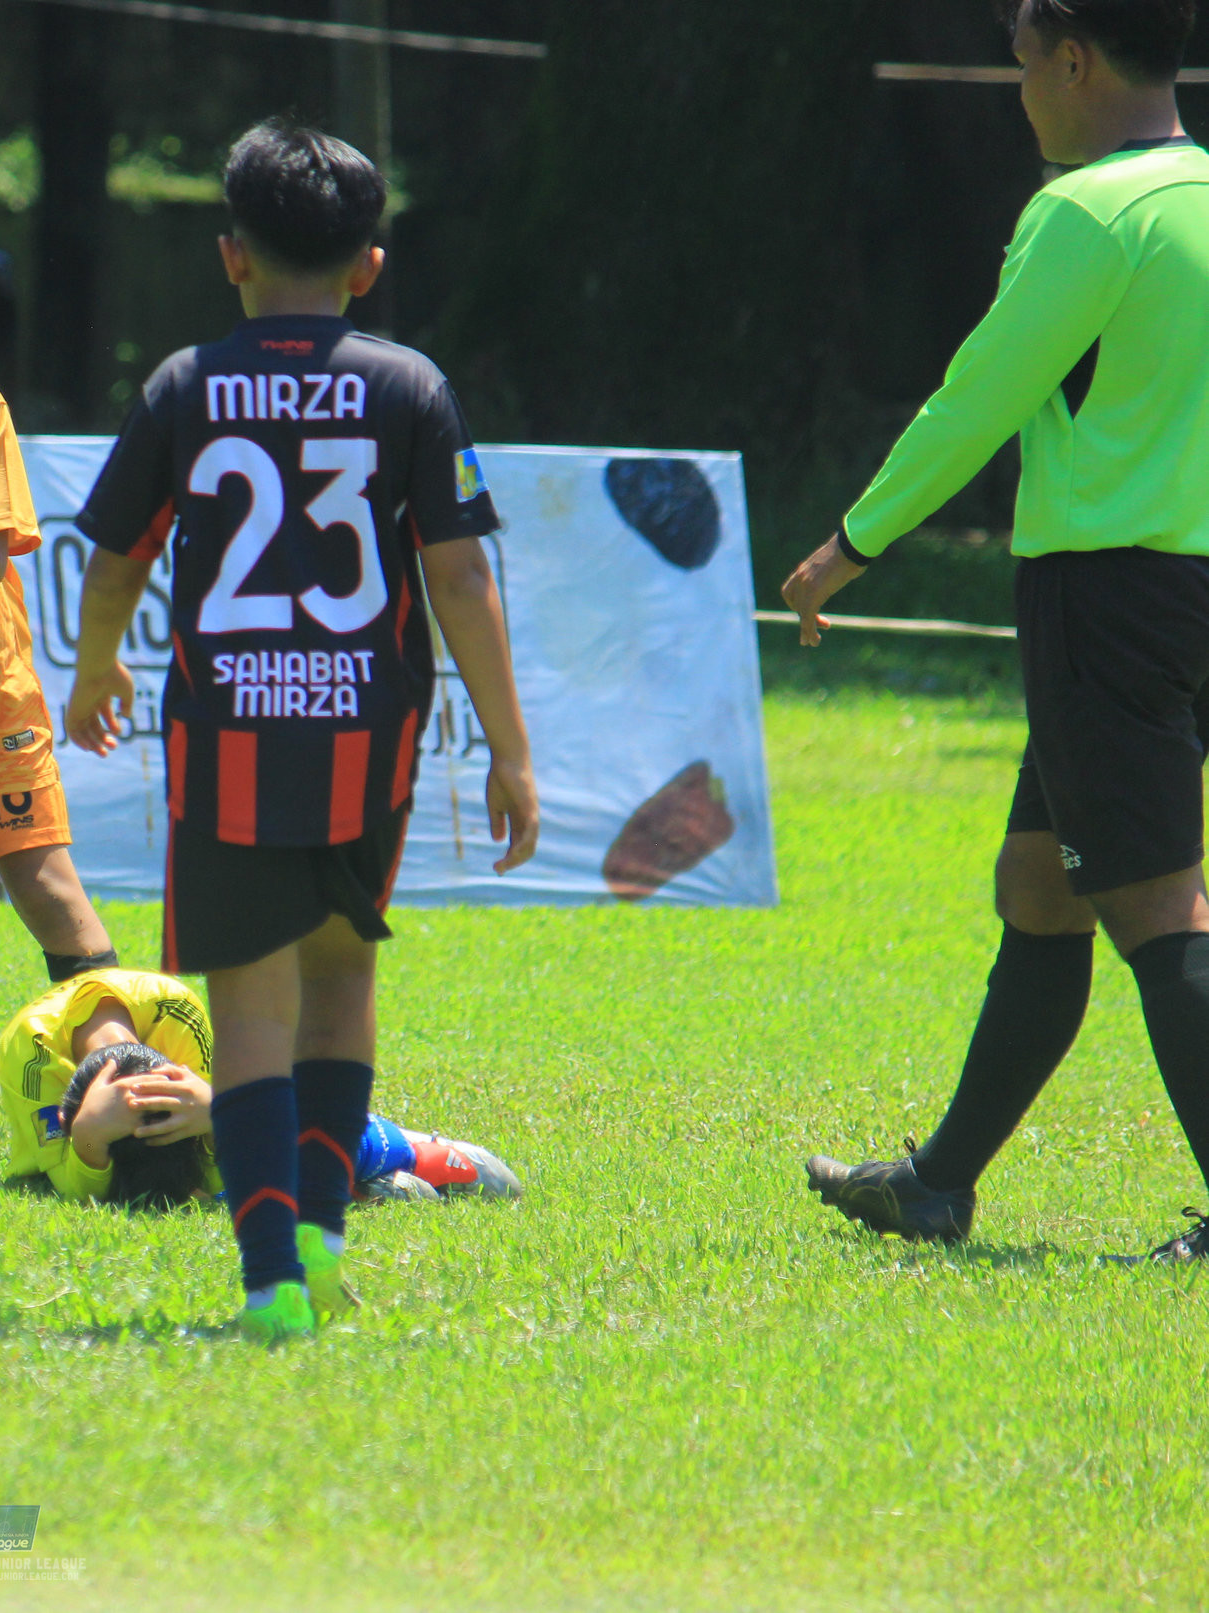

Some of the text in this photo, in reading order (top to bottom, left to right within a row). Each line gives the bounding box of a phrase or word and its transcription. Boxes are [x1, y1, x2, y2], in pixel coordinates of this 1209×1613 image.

[206, 374, 366, 421] MIRZA
[188, 435, 389, 634] 23
[213, 651, 374, 684] SAHABAT
[234, 685, 358, 717] MIRZA
